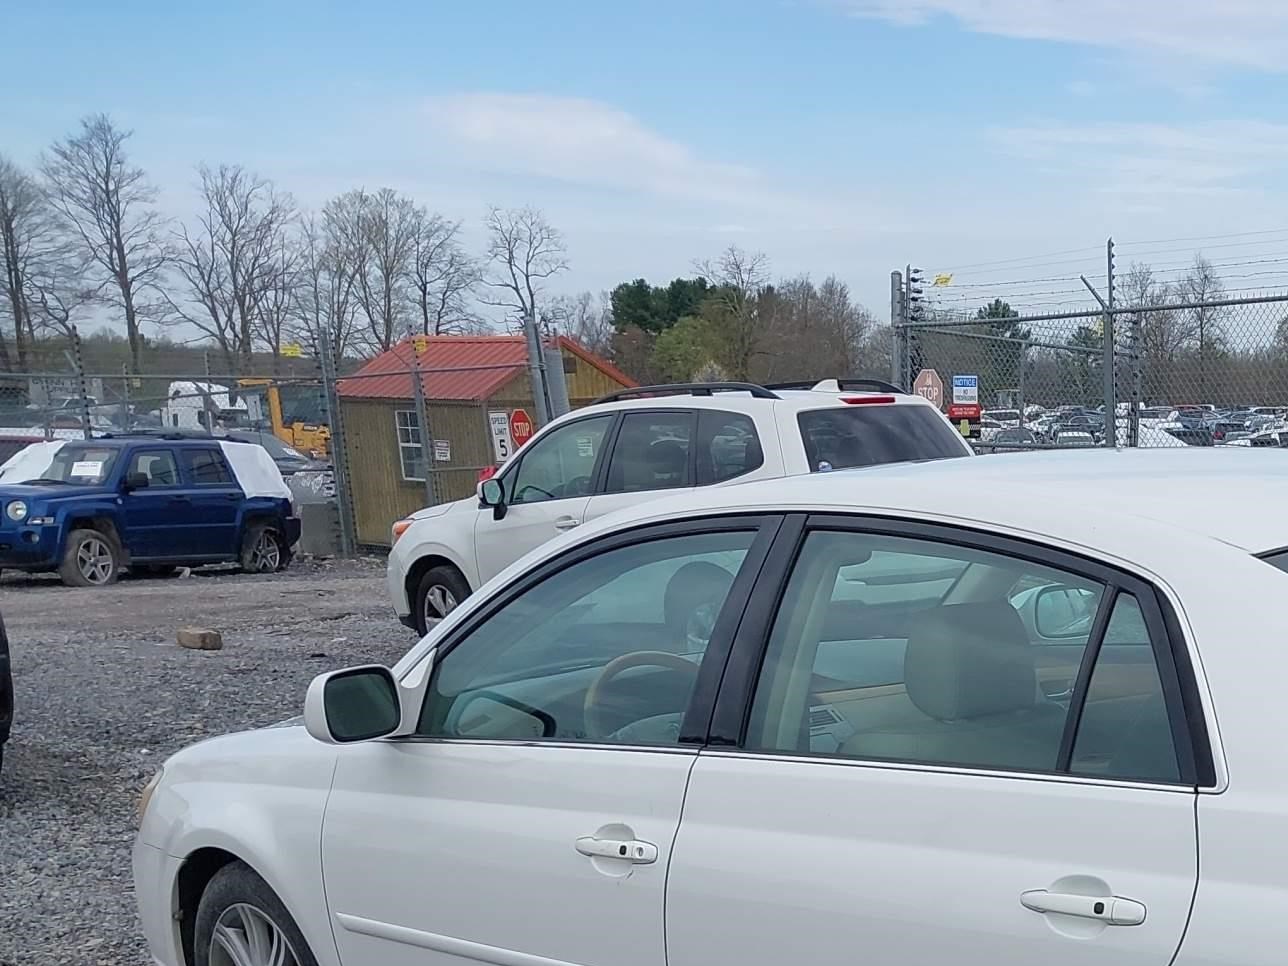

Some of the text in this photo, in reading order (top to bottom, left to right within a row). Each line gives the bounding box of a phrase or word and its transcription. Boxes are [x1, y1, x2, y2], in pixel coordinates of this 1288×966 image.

[917, 387, 939, 401] STOP
[491, 416, 507, 424] SPEED
[513, 422, 530, 437] STOP
[499, 438, 508, 457] 5
